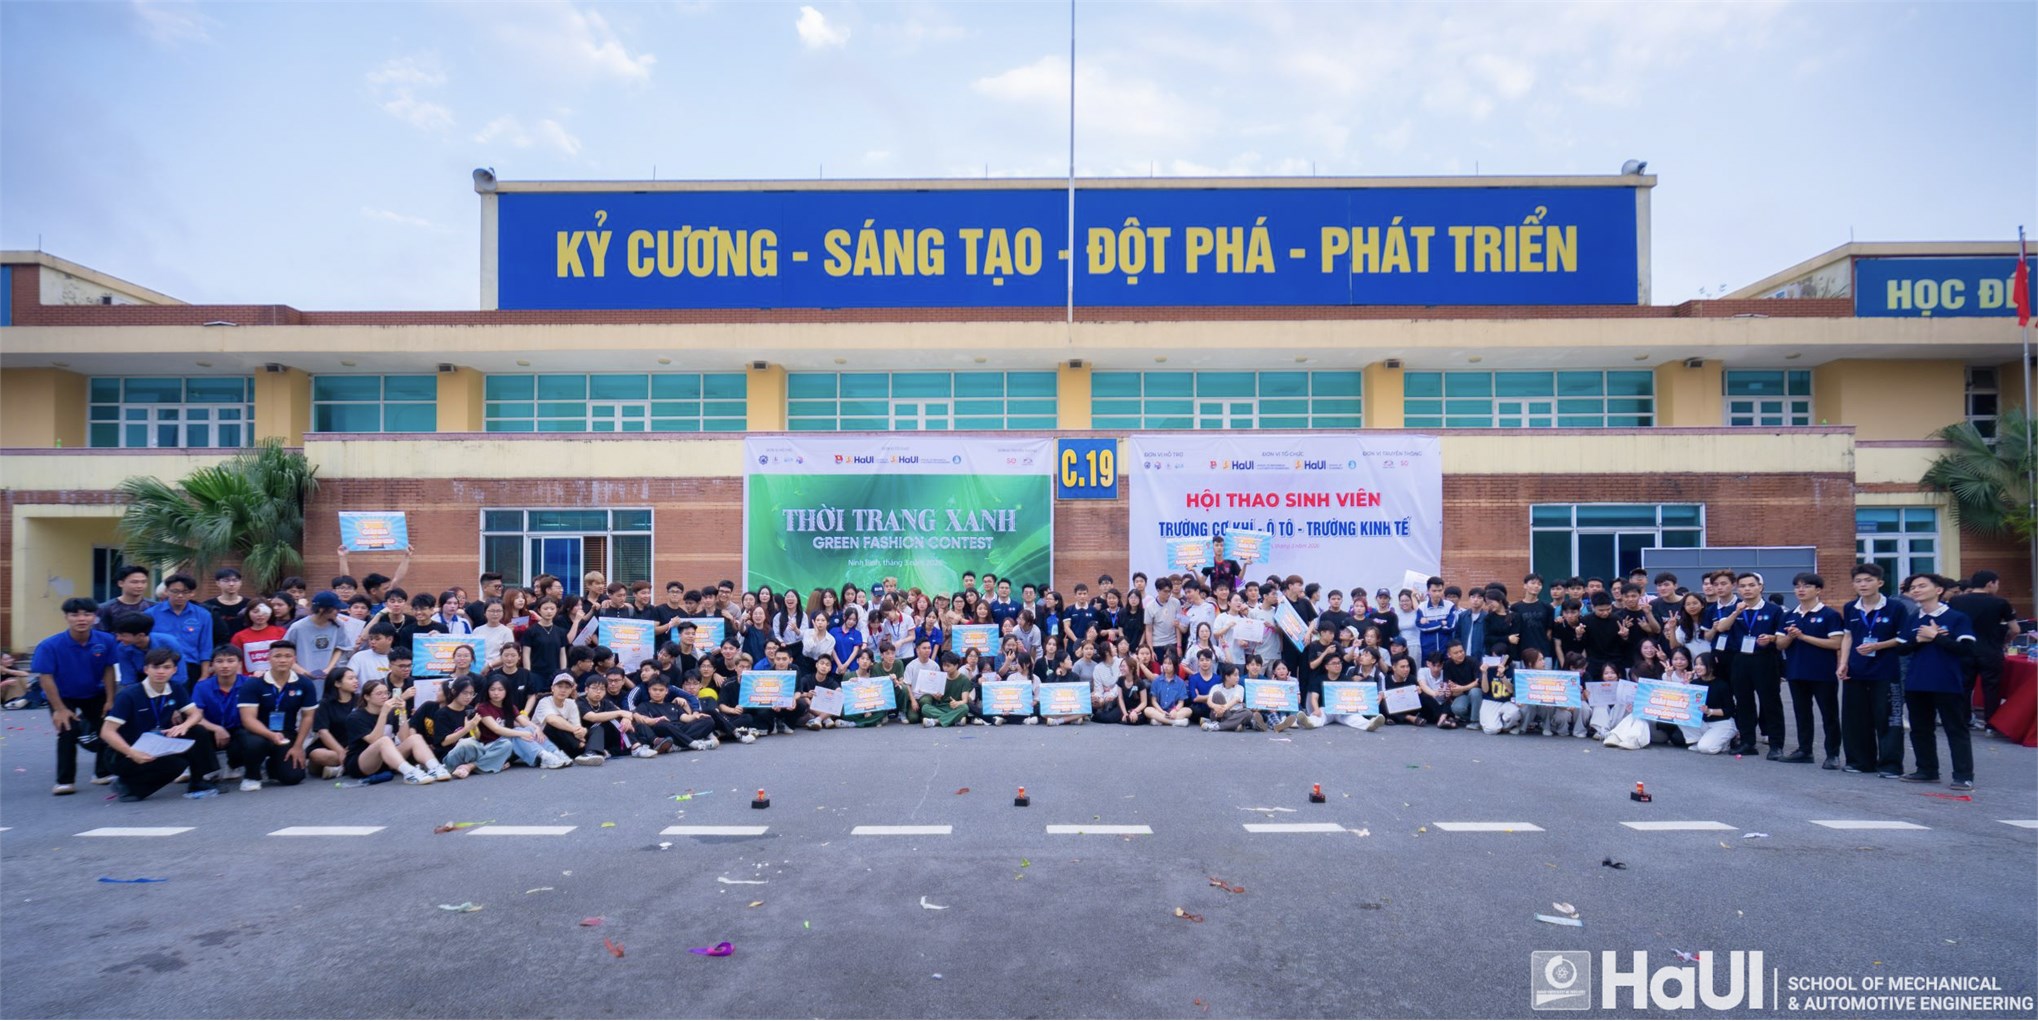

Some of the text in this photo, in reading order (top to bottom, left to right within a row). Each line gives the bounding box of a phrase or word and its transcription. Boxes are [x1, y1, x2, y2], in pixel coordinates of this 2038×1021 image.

[556, 209, 612, 278] KỶ
[626, 224, 778, 278] CƯƠNG
[823, 218, 945, 277] SÁNG
[958, 227, 1042, 286] TẠO
[1086, 216, 1171, 285] ĐỘT
[1185, 215, 1276, 274] PHÁ
[1321, 215, 1436, 274] PHÁT
[1448, 205, 1578, 273] TRIỂN
[1886, 278, 1966, 317] HỌC
[1062, 449, 1114, 487] C.19
[1231, 460, 1254, 470] HaUI
[1304, 460, 1326, 470] HaUI
[1186, 488, 1382, 512] HỘI THAO SINH VIÊN
[783, 504, 1017, 532] THỜI TRANG XANH
[1158, 518, 1208, 537] TRƯỜNG
[1212, 520, 1229, 537] CƠ
[1278, 518, 1294, 536] TÔ
[1306, 517, 1356, 536] TRƯỜNG
[1361, 521, 1391, 536] KINH
[1394, 516, 1410, 536] TẾ
[812, 536, 994, 550] GREEN FASHION CONTEST
